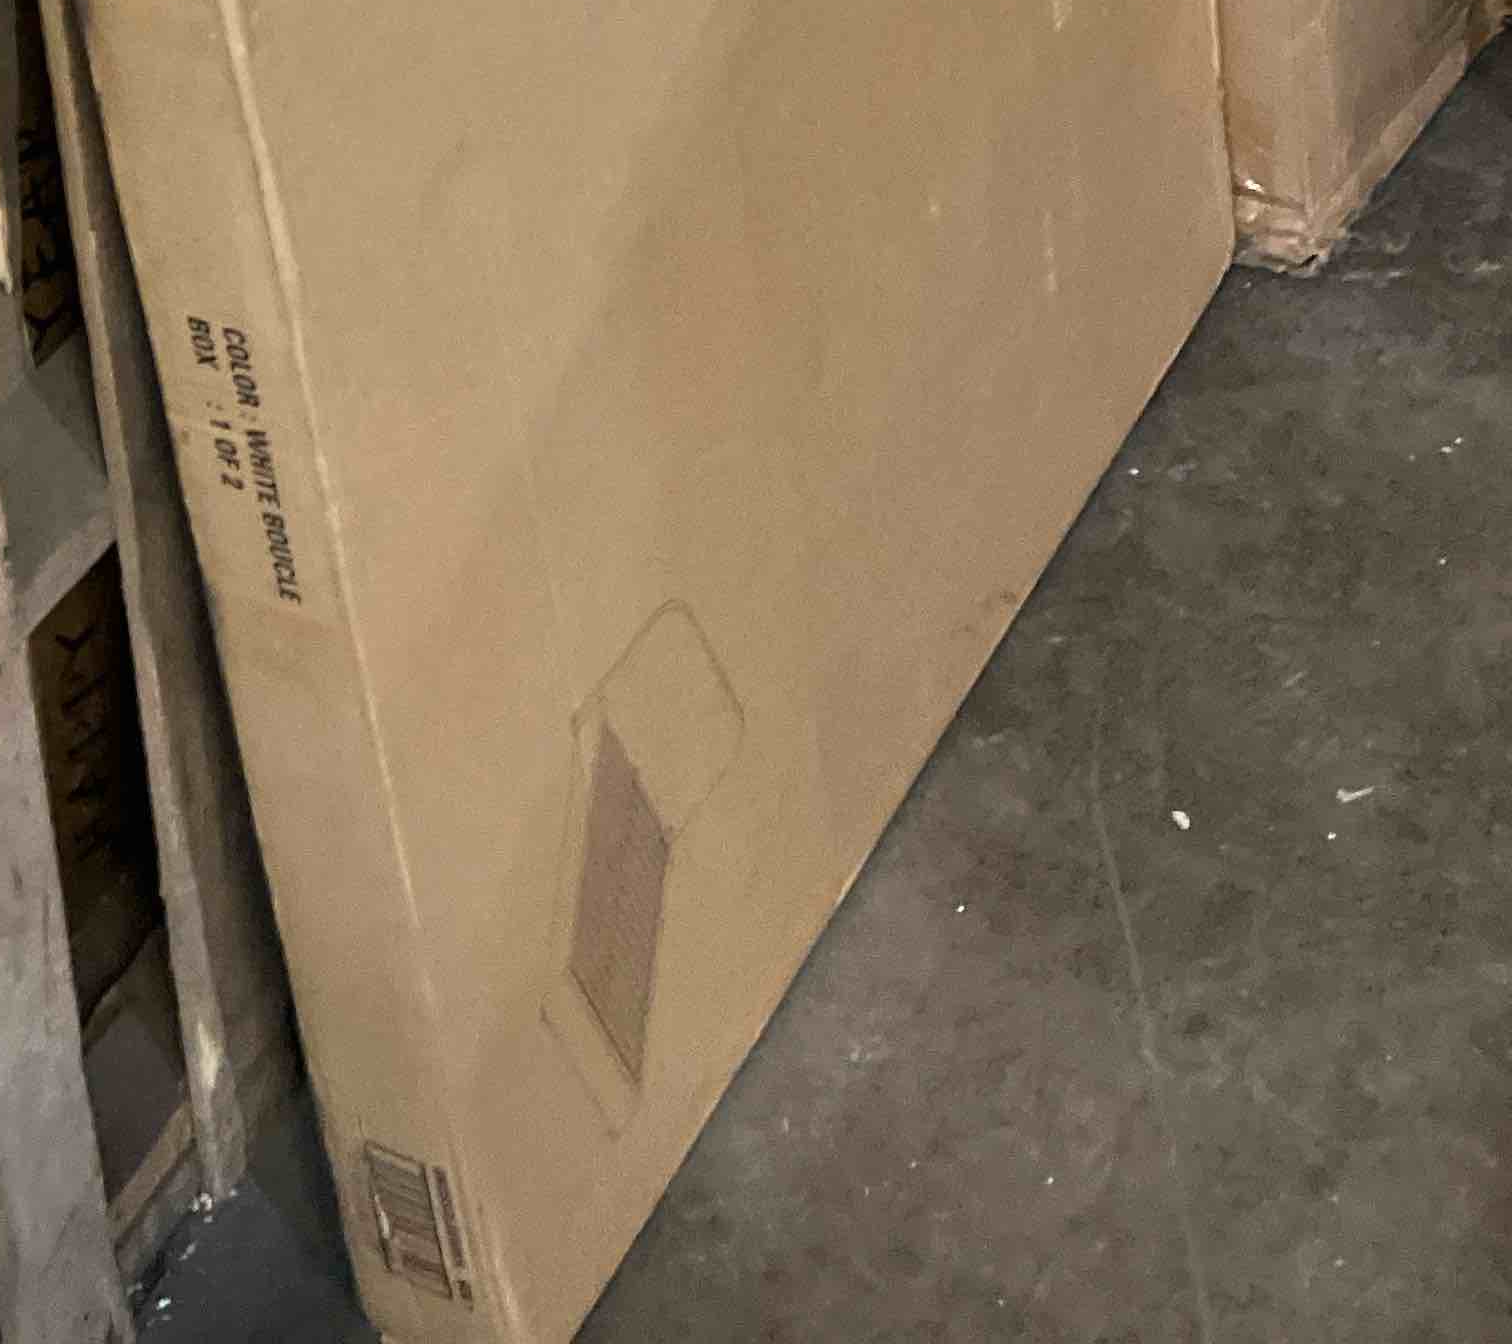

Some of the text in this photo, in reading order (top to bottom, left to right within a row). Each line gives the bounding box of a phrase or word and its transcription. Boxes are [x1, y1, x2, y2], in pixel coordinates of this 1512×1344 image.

[186, 315, 220, 372] BOX
[221, 326, 261, 409] COLOR
[213, 437, 241, 472] OF
[220, 472, 245, 491] 2
[245, 428, 281, 510] WHITE
[261, 511, 303, 605] BOUCLE
